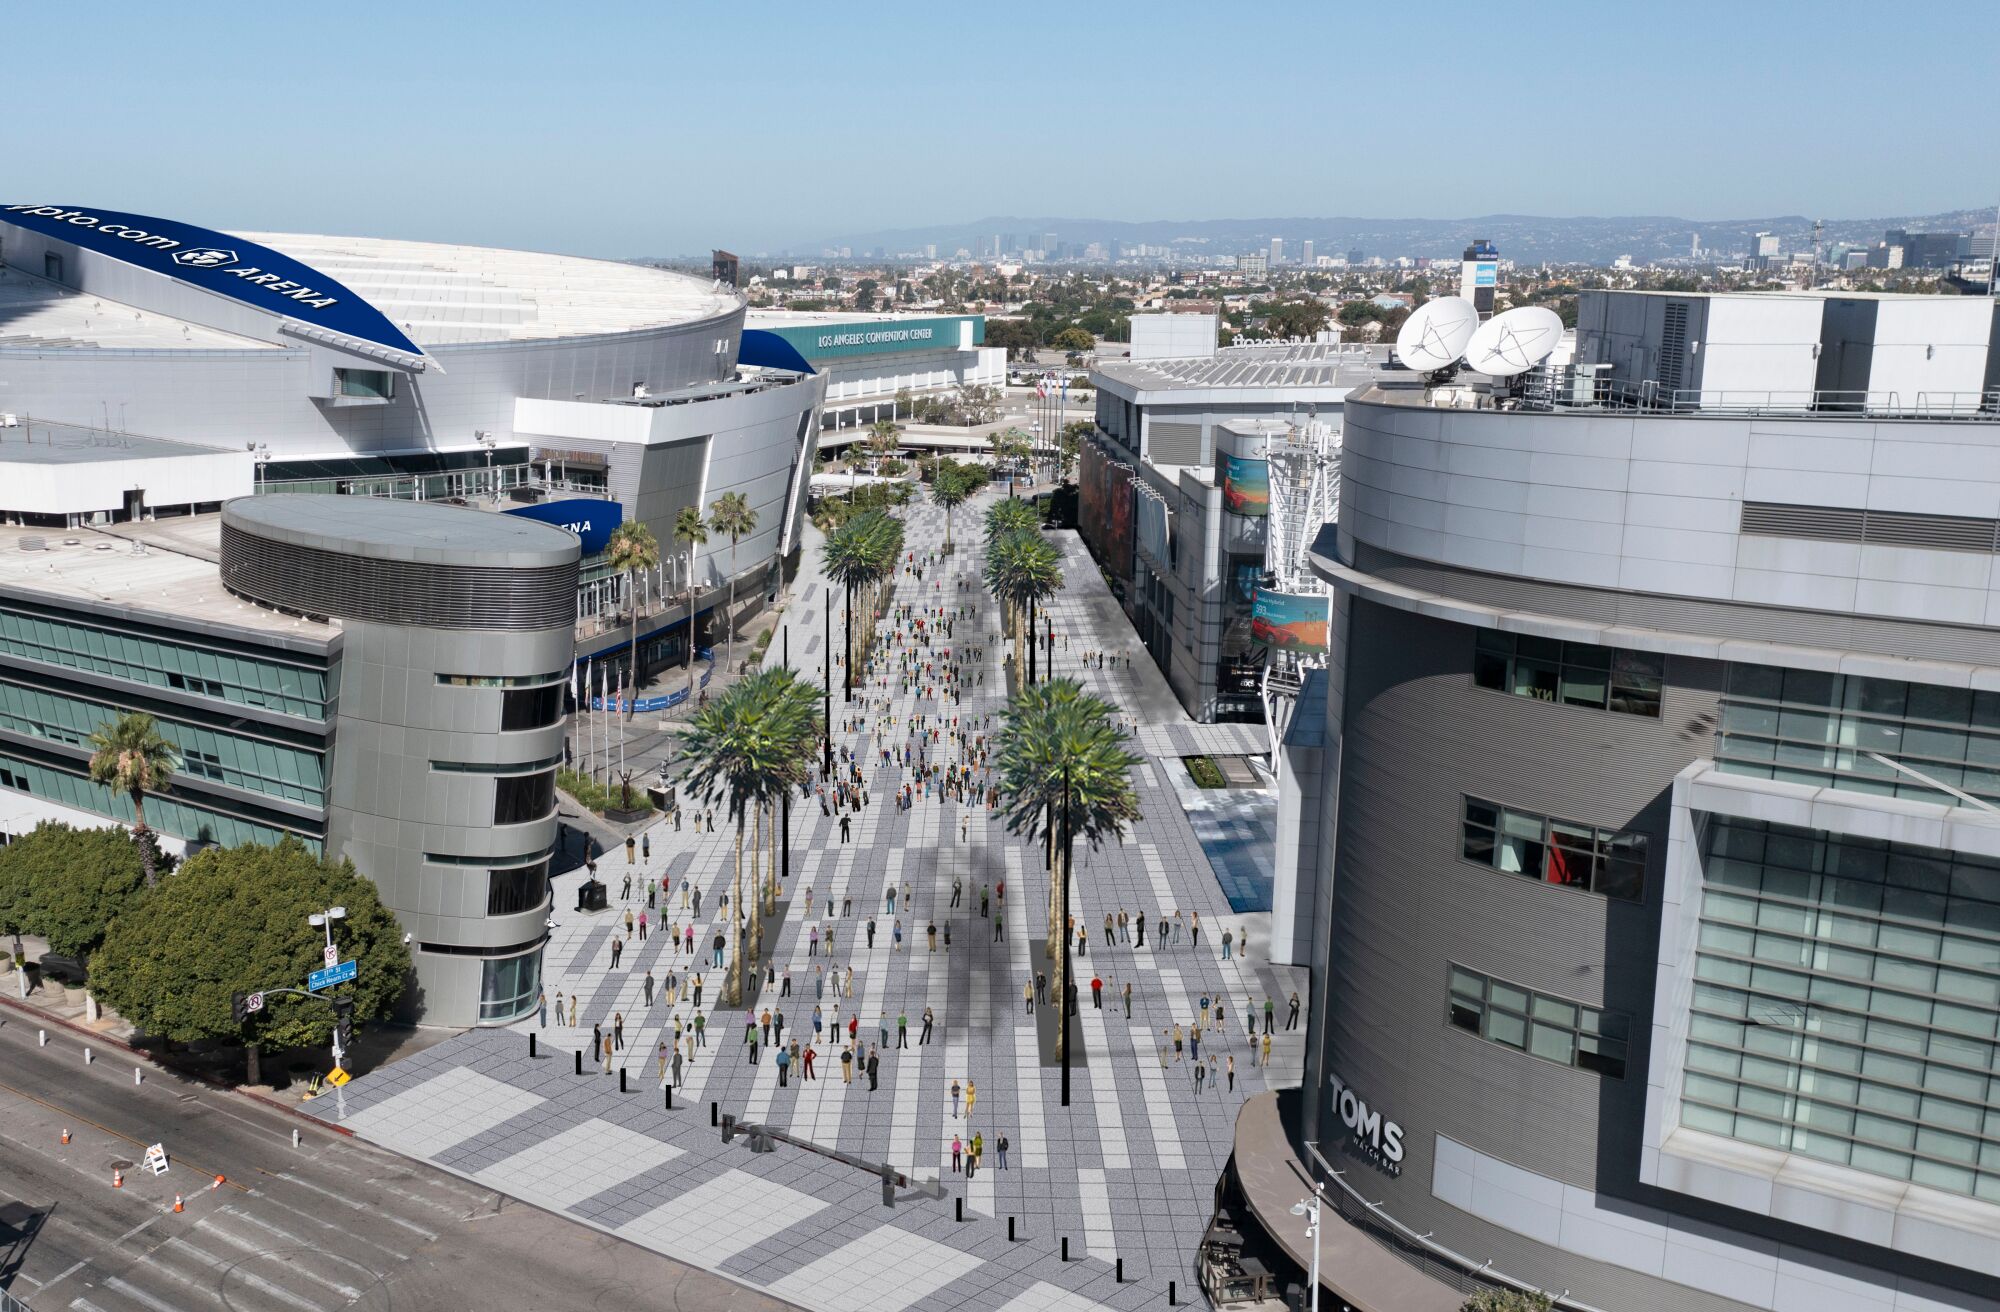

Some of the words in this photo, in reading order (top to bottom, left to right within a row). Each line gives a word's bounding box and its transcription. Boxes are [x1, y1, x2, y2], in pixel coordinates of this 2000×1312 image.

[223, 267, 338, 309] ARENA
[818, 335, 833, 347] LOS
[833, 333, 864, 346] ANGELES
[865, 330, 909, 343] CONVENTION
[910, 328, 933, 340] CENTER
[1330, 1072, 1404, 1162] TOMS
[1353, 1135, 1379, 1161] WATCH
[1382, 1158, 1400, 1175] BAR
